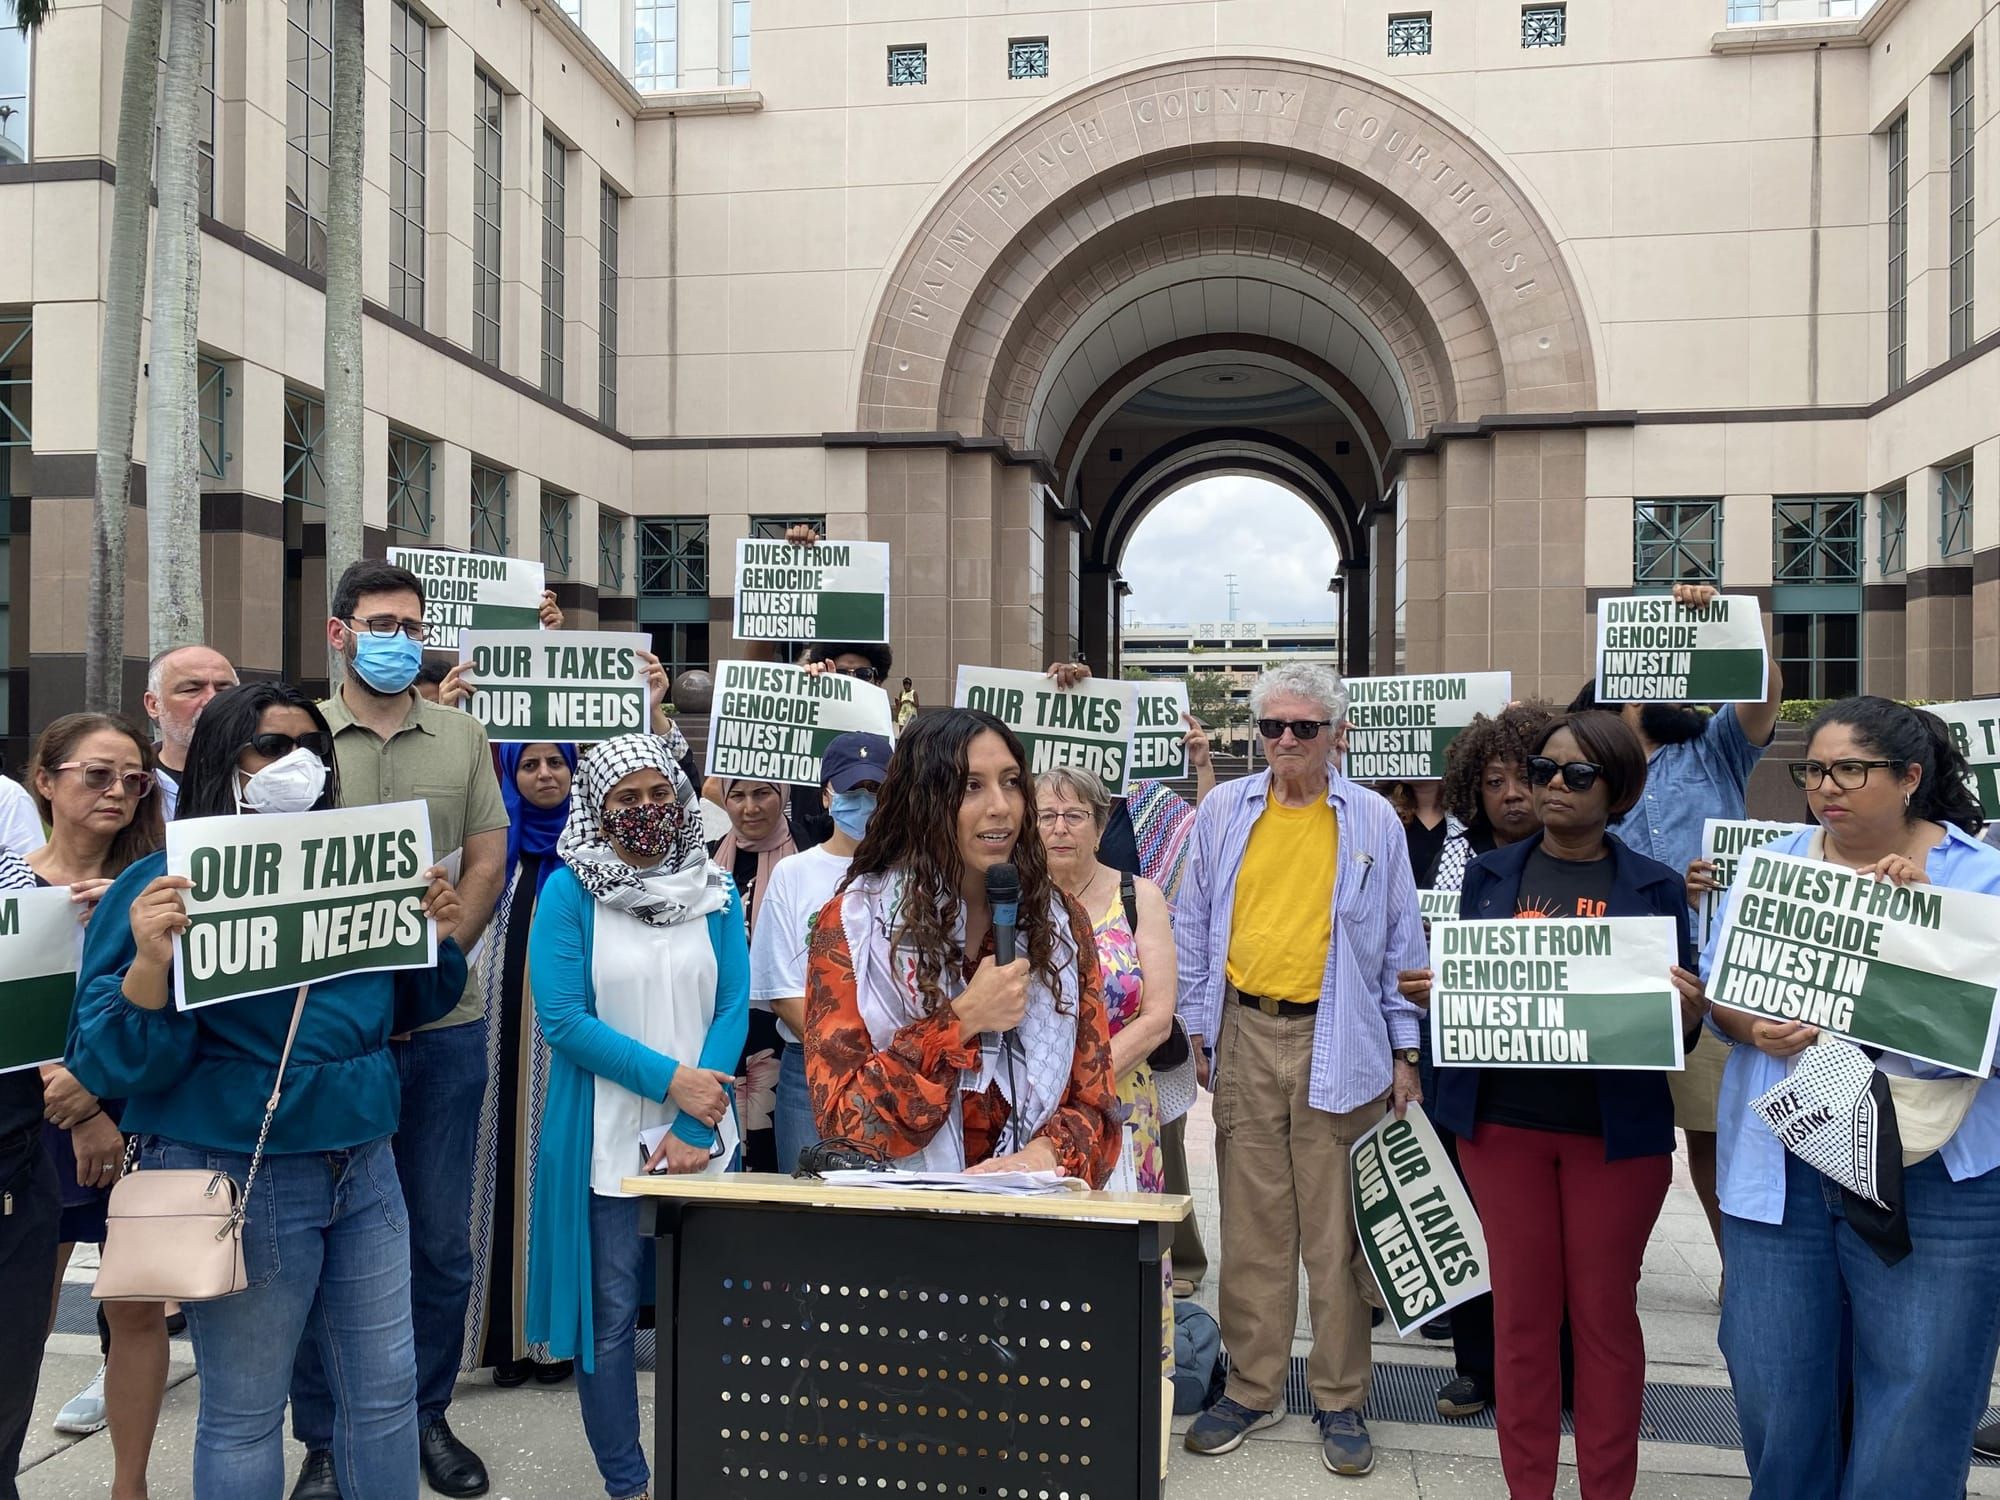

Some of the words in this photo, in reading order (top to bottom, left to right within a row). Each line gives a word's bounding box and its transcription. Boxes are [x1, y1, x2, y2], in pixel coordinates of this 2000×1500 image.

[910, 226, 975, 321] PALM
[986, 118, 1104, 208] BEACH
[1137, 88, 1297, 123] COUNTY
[1334, 106, 1539, 299] COURTHOUSE
[396, 552, 455, 577] DIVEST
[457, 557, 507, 581] FROM
[744, 544, 803, 566] DIVEST
[804, 546, 850, 567] FROM
[421, 577, 478, 602] OCIDE
[742, 568, 823, 590] GENOCIDE
[422, 601, 454, 625] EST
[455, 604, 473, 626] IN
[742, 592, 801, 615] INVEST
[802, 593, 818, 616] IN
[1607, 600, 1672, 623] DIVEST
[1674, 600, 1729, 623] FROM
[743, 615, 816, 638] HOUSING
[1606, 626, 1698, 649] GENOCIDE
[472, 645, 532, 678] OUR
[544, 646, 635, 681] TAXES
[1605, 652, 1671, 675] INVEST
[1672, 652, 1691, 675] IN
[725, 666, 795, 694] DIVEST
[797, 671, 852, 702] FROM
[1350, 680, 1410, 703] DIVEST
[1413, 678, 1467, 701] FROM
[1606, 676, 1688, 699] HOUSING
[472, 690, 532, 727] OUR
[548, 692, 640, 728] NEEDS
[721, 692, 820, 726] GENOCIDE
[967, 686, 1024, 724] OUR
[1035, 692, 1122, 734] TAXES
[1137, 696, 1179, 727] XES
[1349, 704, 1436, 728] GENOCIDE
[718, 719, 791, 752] INVEST
[791, 729, 814, 756] IN
[1130, 736, 1182, 768] EEDS
[1349, 729, 1412, 753] INVEST
[1413, 729, 1433, 752] IN
[714, 747, 823, 783] EDUCATION
[1031, 739, 1122, 782] NEEDS
[1351, 753, 1431, 777] HOUSING
[189, 841, 282, 903] OUR
[300, 828, 418, 891] TAXES
[1748, 857, 1850, 908] DIVEST
[1850, 874, 1942, 930] FROM
[188, 915, 279, 981] OUR
[300, 896, 423, 964] NEEDS
[1443, 925, 1530, 956] DIVEST
[1534, 925, 1612, 956] FROM
[1739, 894, 1884, 957] GENOCIDE
[1442, 960, 1569, 992] GENOCIDE
[1728, 931, 1836, 987] INVEST
[1833, 957, 1869, 997] IN
[1442, 994, 1532, 1027] INVEST
[1537, 997, 1565, 1028] IN
[1722, 968, 1855, 1033] HOUSING
[1443, 1028, 1589, 1063] EDUCATION
[1765, 1090, 1804, 1125] FREE
[1778, 1106, 1835, 1150] LESTINE
[1356, 1141, 1389, 1212] OUR
[1382, 1119, 1432, 1188] OUR
[1409, 1185, 1480, 1288] TAXES
[1370, 1211, 1437, 1318] NEEDS
